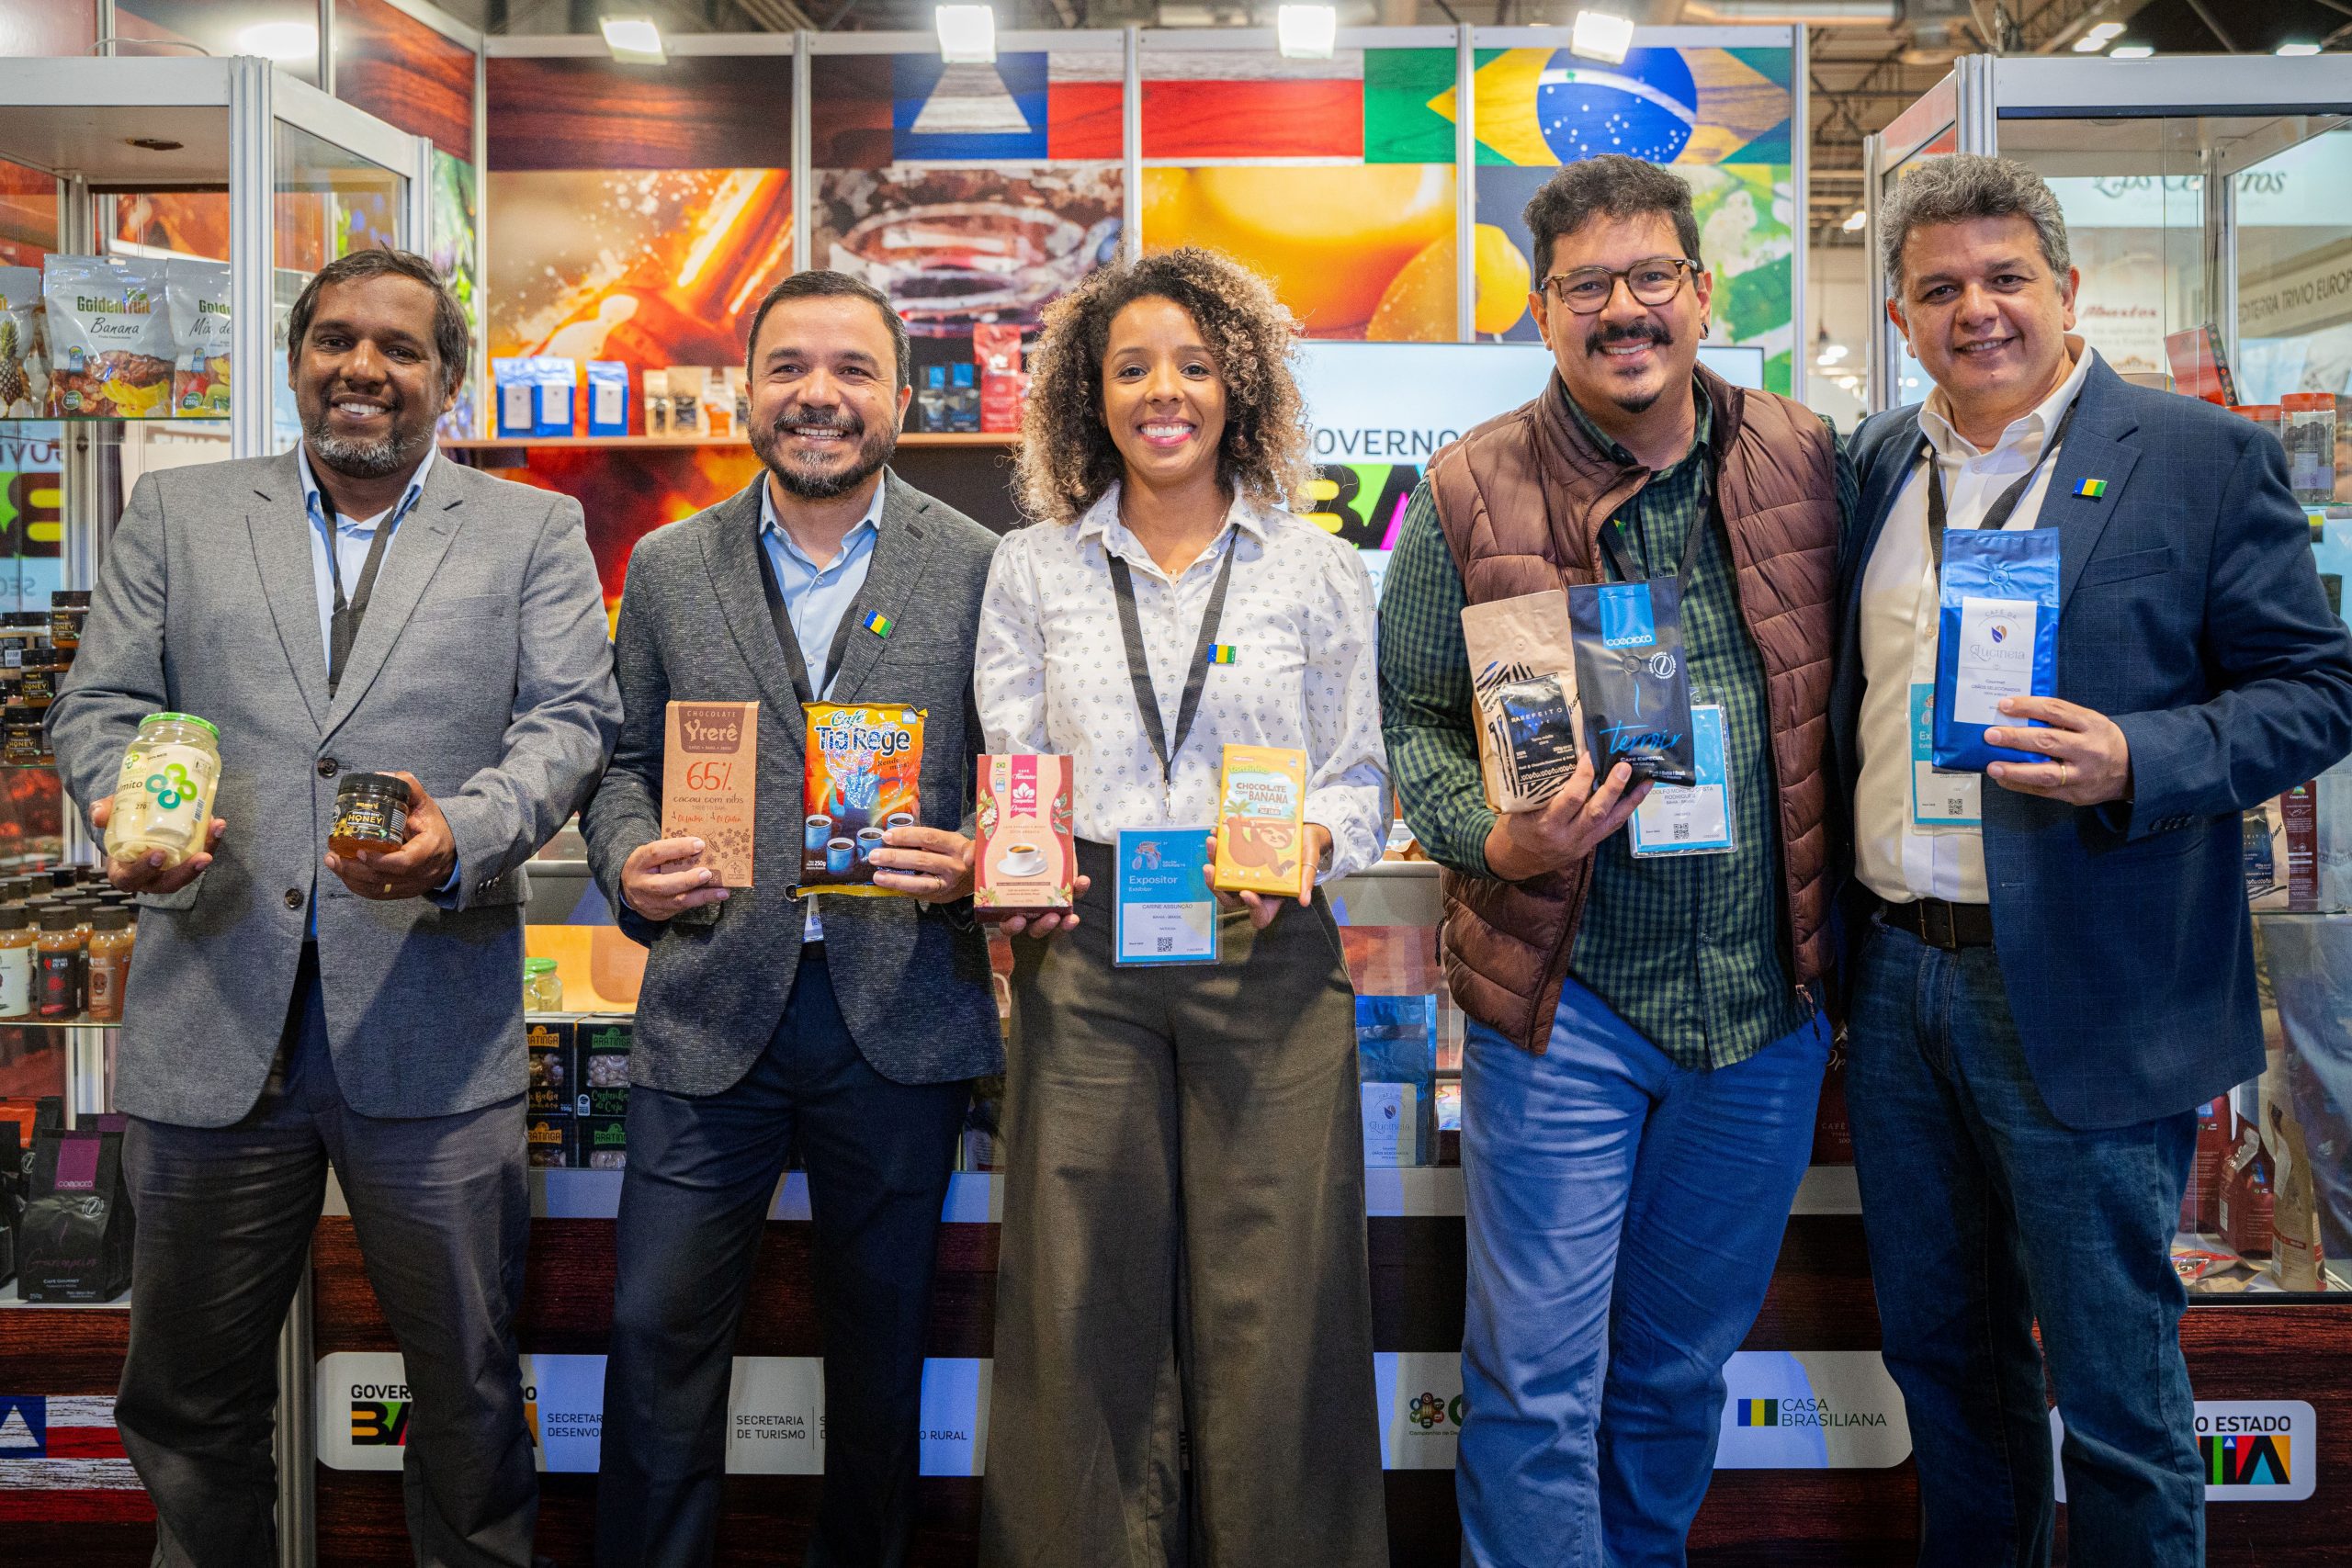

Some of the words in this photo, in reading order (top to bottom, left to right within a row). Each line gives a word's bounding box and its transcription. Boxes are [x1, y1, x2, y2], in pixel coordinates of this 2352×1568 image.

[91, 318, 140, 334] Banana
[189, 318, 211, 336] Mix
[1314, 428, 1459, 457] OVERNO
[686, 710, 737, 718] CHOCOLATE
[831, 709, 867, 728] Café
[684, 718, 739, 743] Yrerê
[686, 761, 733, 792] 65%
[1236, 782, 1286, 793] CHOCOLATE
[673, 795, 702, 805] cacau
[704, 795, 724, 805] com
[726, 793, 745, 805] nibs
[1248, 792, 1288, 805] BANANA
[347, 814, 383, 825] HONEY
[814, 860, 827, 868] 250g
[1129, 875, 1178, 886] Expositor
[351, 1383, 412, 1399] GOVER
[1781, 1398, 1829, 1412] CASA
[548, 1413, 602, 1424] SECRETAR
[736, 1415, 804, 1426] SECRETARIA
[1781, 1413, 1887, 1427] BRASILIANA
[2215, 1416, 2291, 1432] ESTADO
[548, 1427, 601, 1438] DESENVO
[737, 1429, 752, 1439] DE
[757, 1429, 806, 1439] TURISMO
[930, 1429, 967, 1440] RURAL
